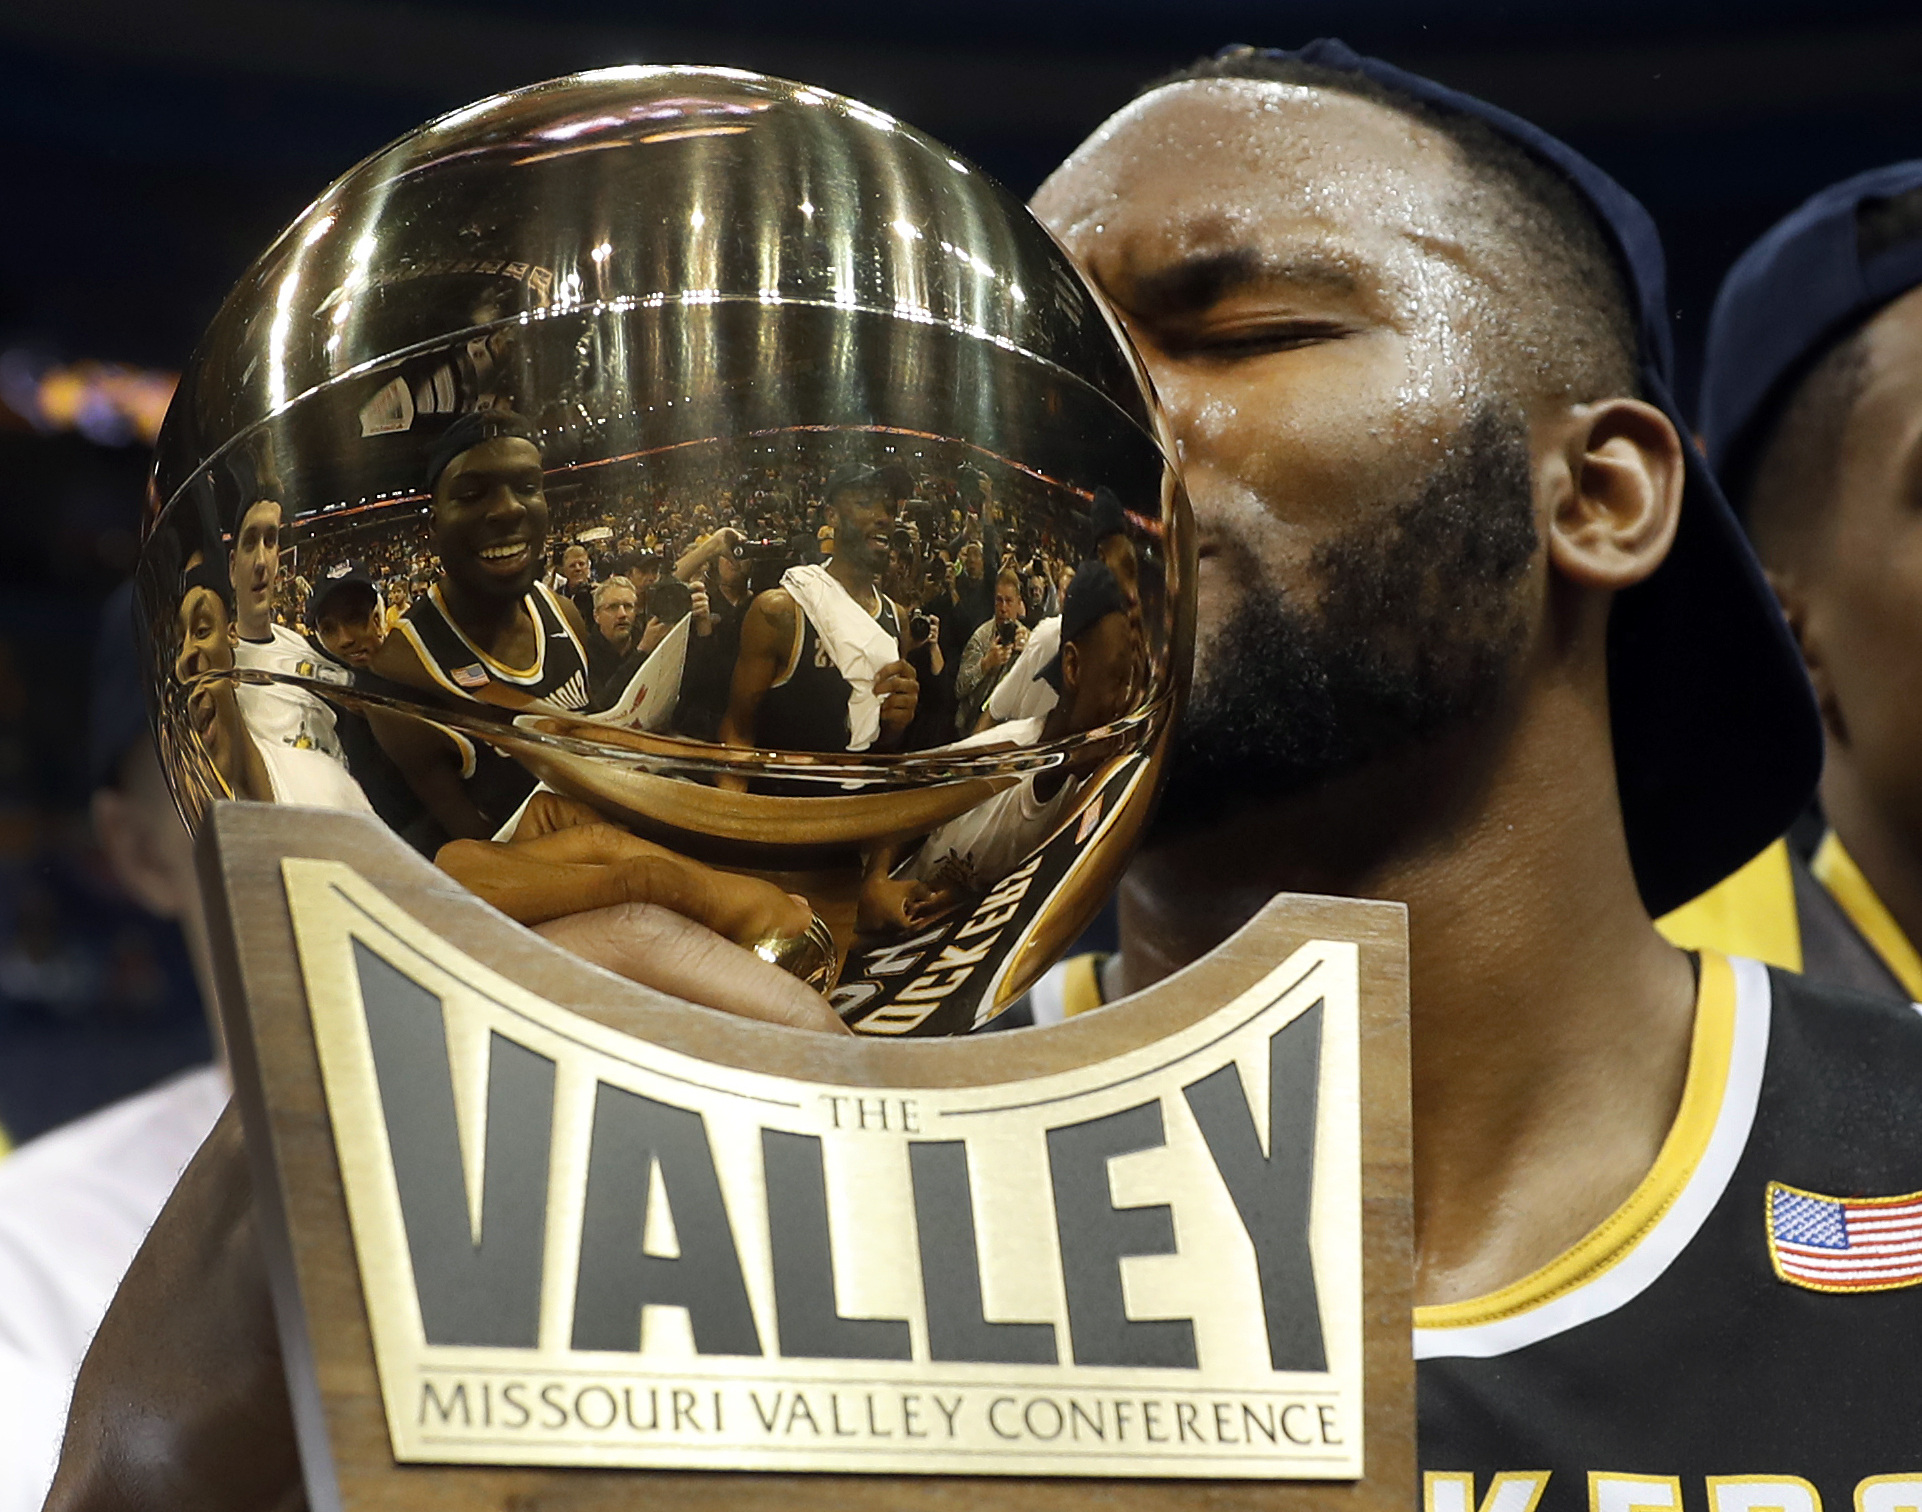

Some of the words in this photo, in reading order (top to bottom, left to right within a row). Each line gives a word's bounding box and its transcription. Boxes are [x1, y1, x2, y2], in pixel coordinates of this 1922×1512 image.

[818, 1094, 920, 1133] THE
[351, 934, 1329, 1373] VALLEY
[418, 1379, 726, 1432] MISSOURI
[749, 1391, 963, 1438] VALLEY
[988, 1397, 1344, 1446] CONFERENCE
